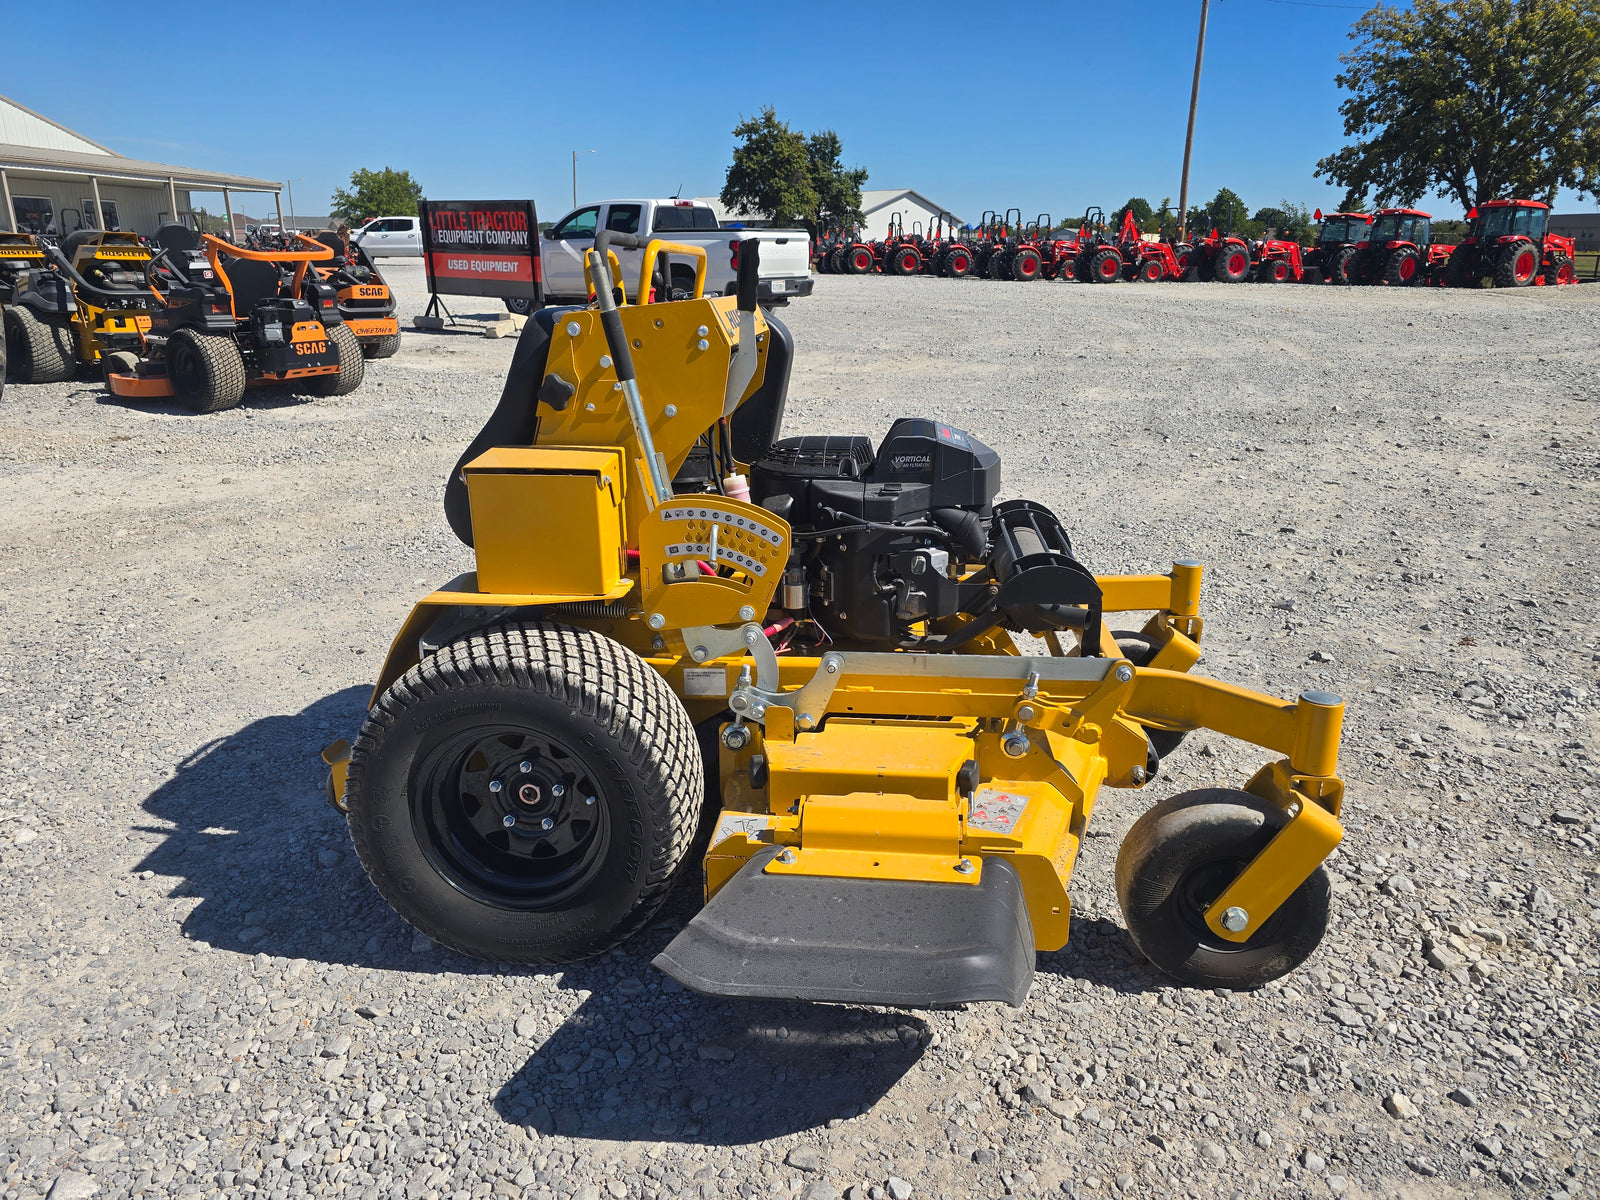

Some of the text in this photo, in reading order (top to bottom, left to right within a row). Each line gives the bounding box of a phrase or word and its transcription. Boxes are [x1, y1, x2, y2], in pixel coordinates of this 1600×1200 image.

[429, 211, 527, 231] LITTLE TRACTOR
[438, 230, 483, 244] EQUIPMENT
[486, 230, 528, 245] COMPANY
[447, 259, 519, 273] USED EQUIPMENT
[360, 288, 383, 296] SCAG
[356, 327, 388, 335] CHEETAH
[295, 342, 327, 355] SCAG
